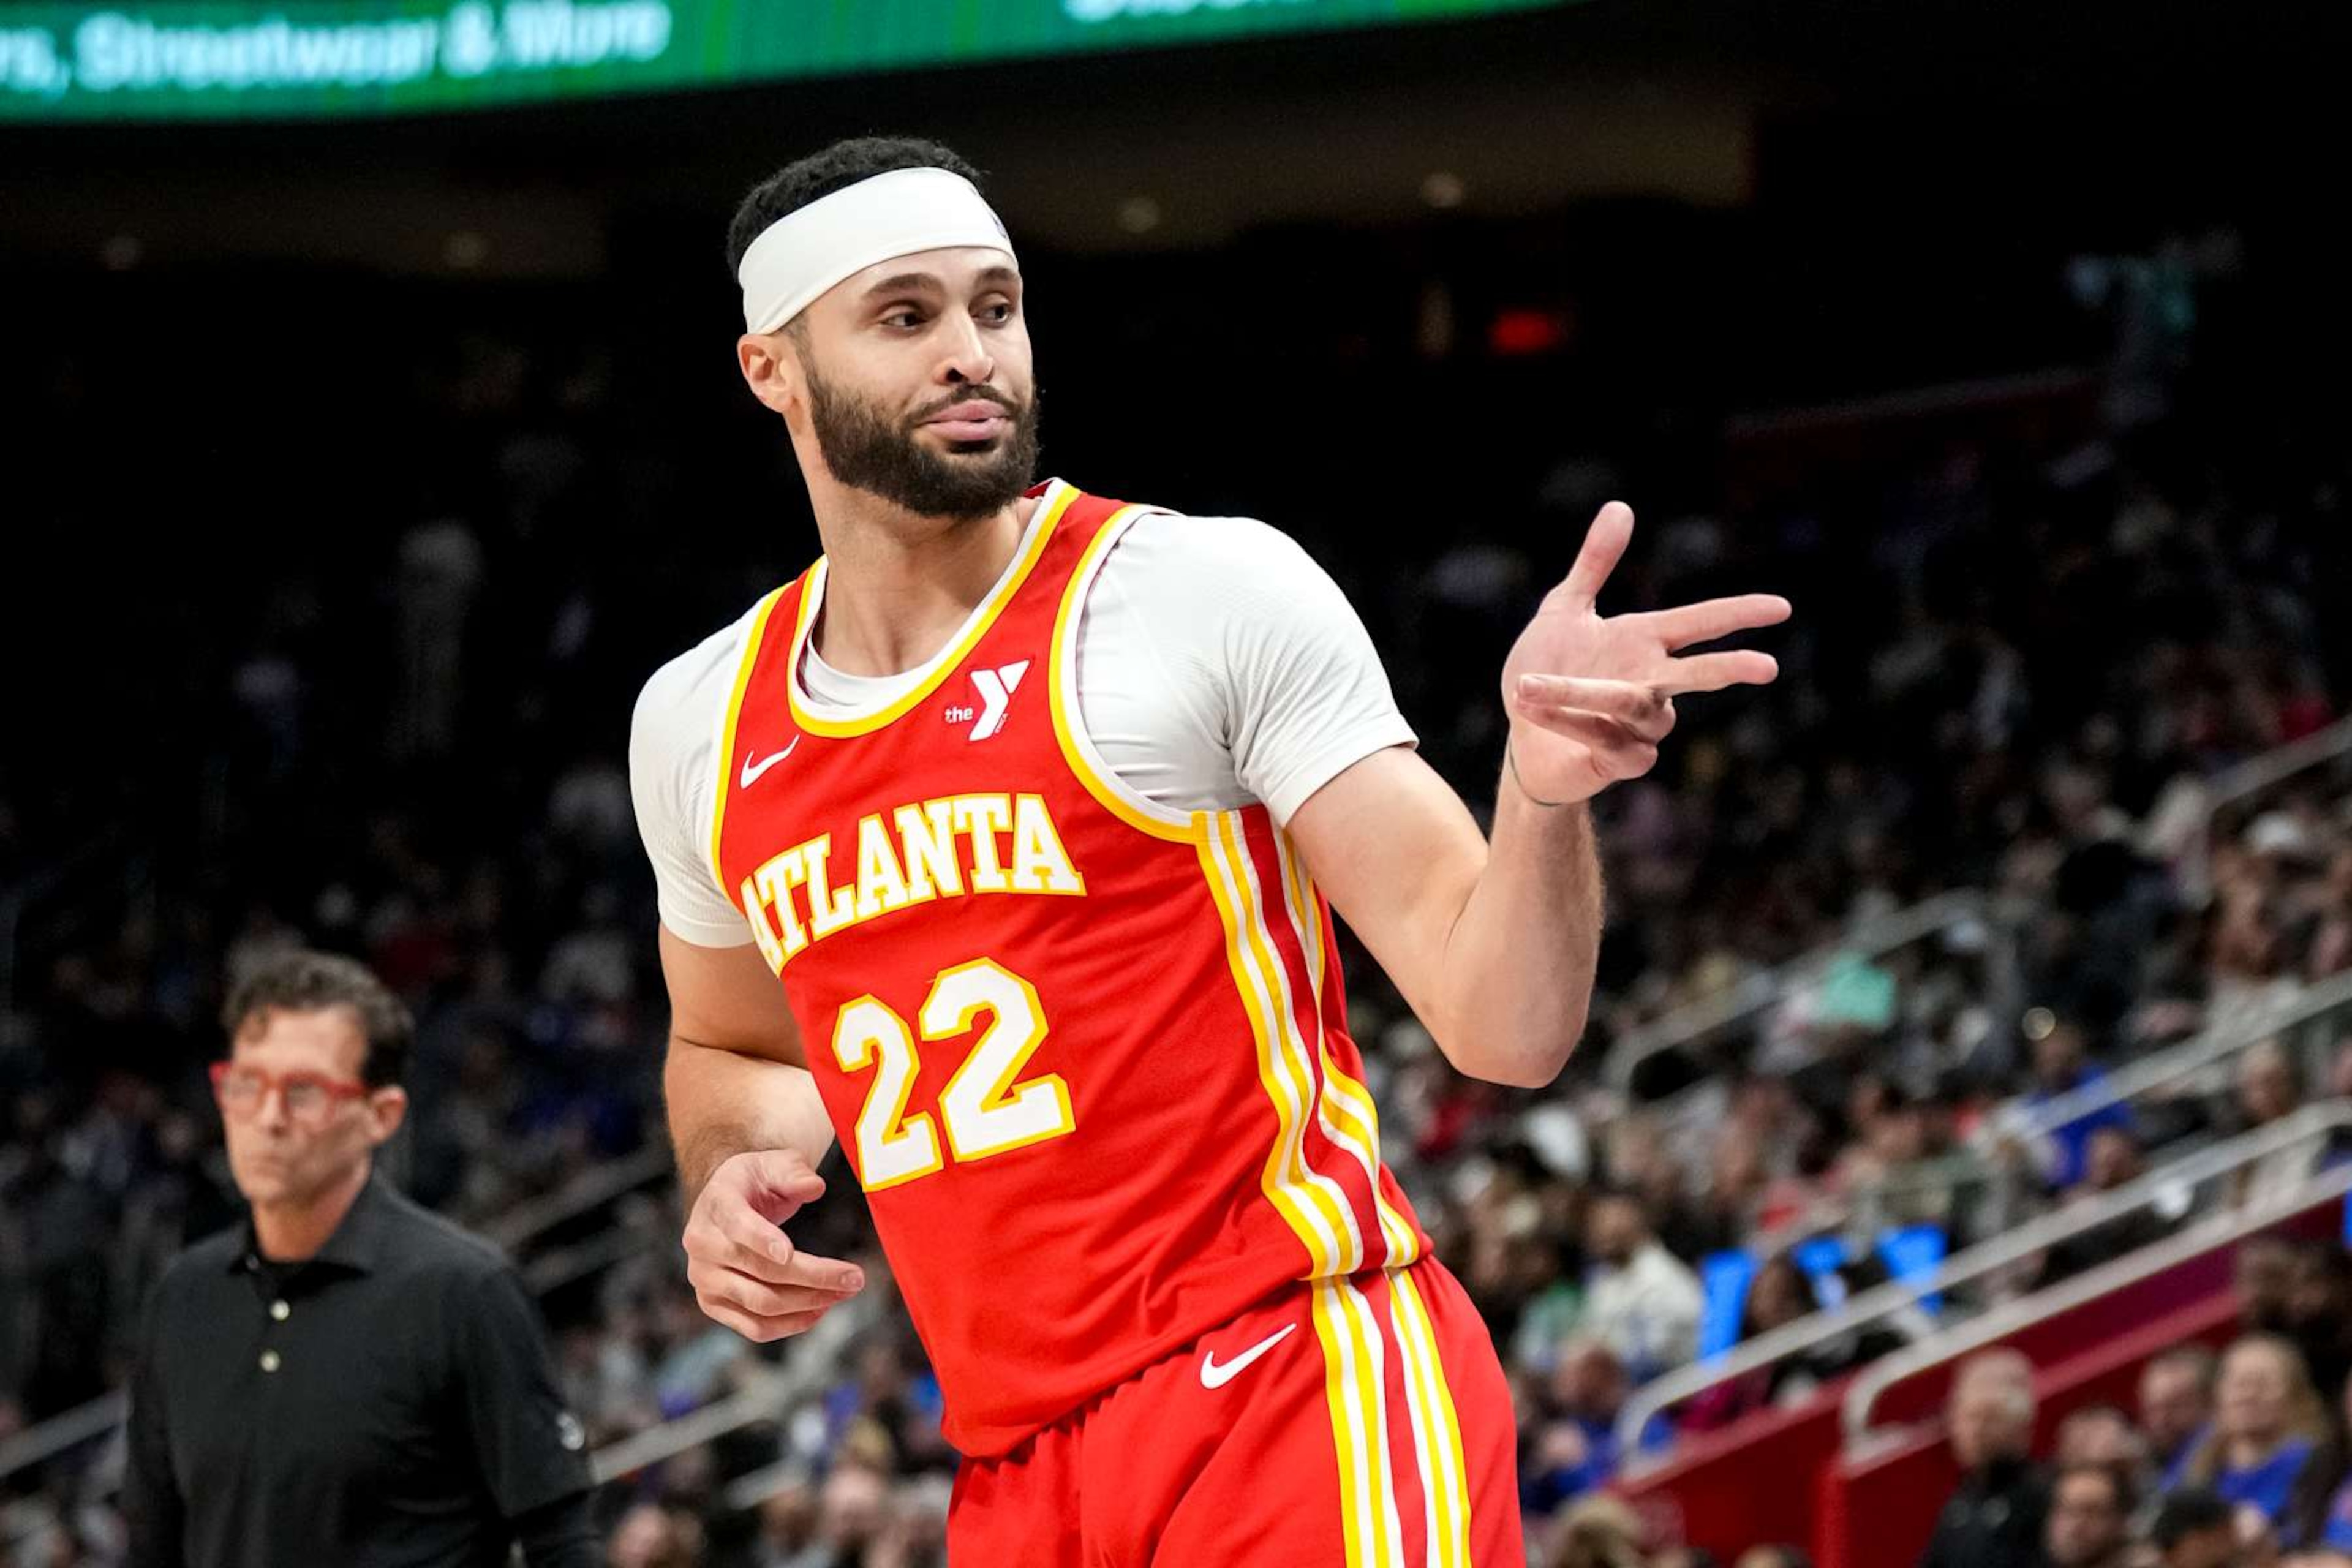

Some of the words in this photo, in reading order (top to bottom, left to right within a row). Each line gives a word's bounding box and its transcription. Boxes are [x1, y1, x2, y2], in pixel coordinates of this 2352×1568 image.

[76, 12, 437, 92] Streetwear
[441, 1, 492, 77] &
[504, 0, 672, 67] More
[944, 706, 974, 724] the
[740, 793, 1087, 978] ATLANTA
[831, 956, 1076, 1193] 22
